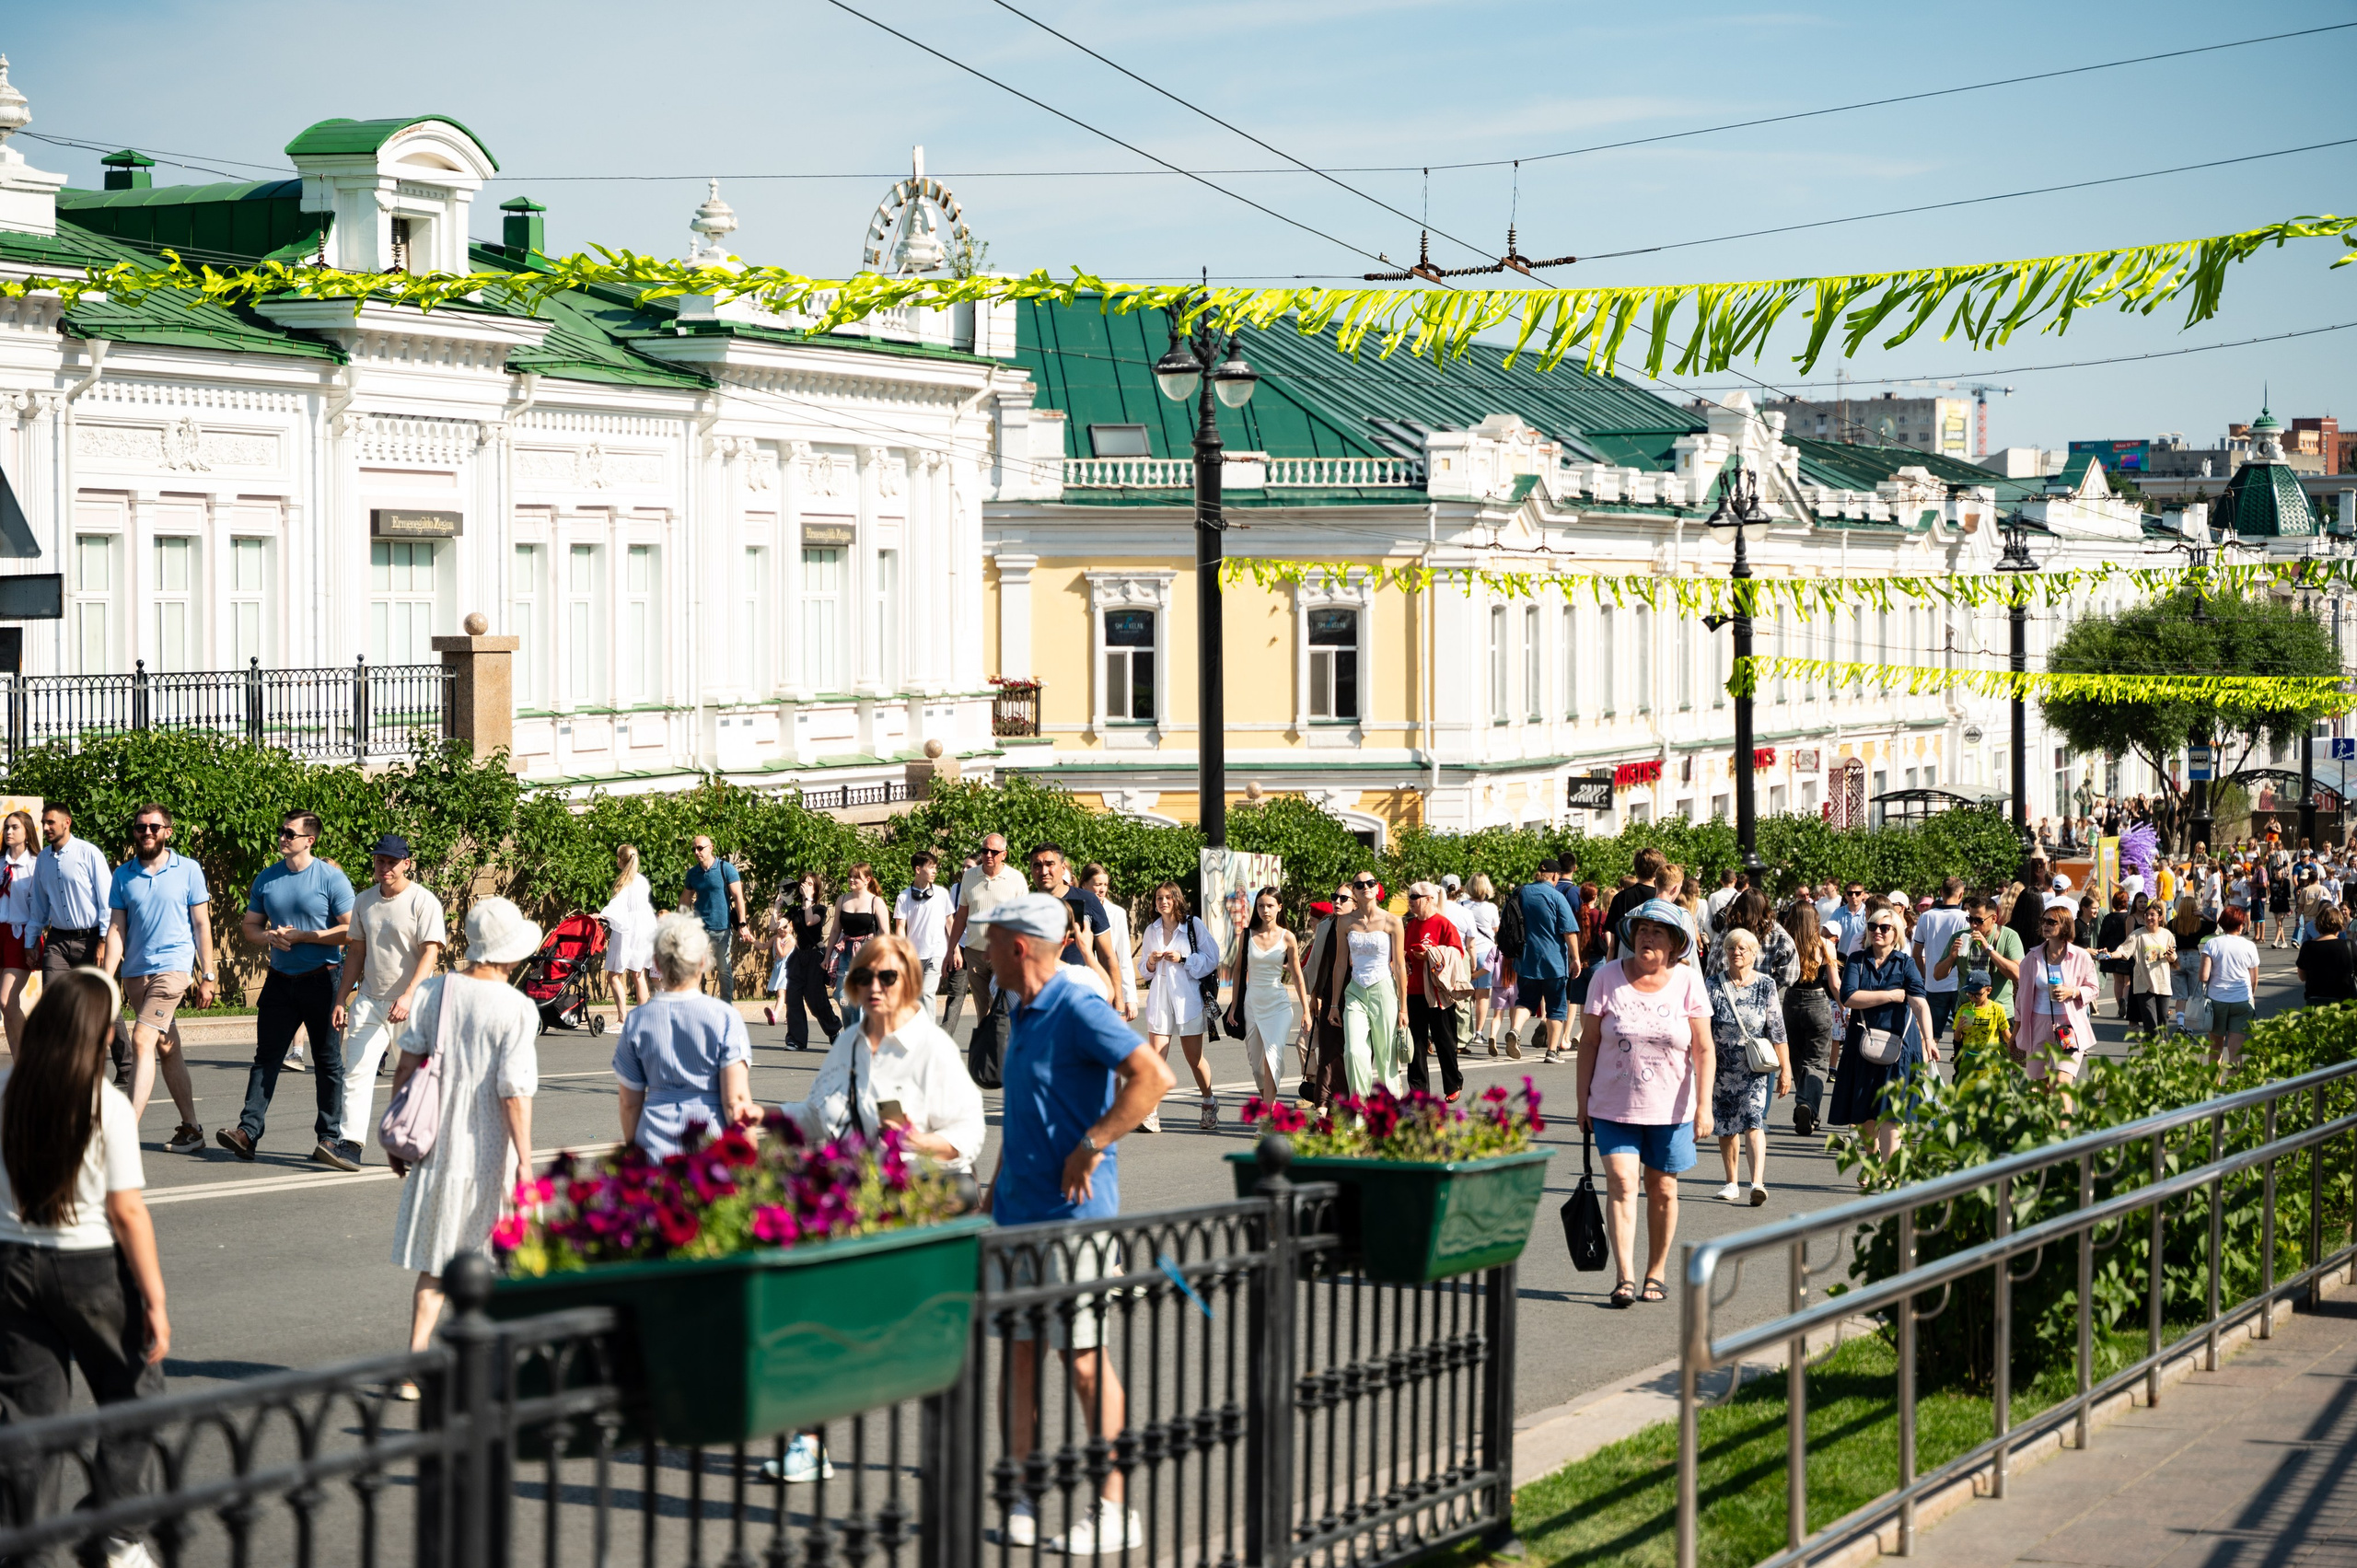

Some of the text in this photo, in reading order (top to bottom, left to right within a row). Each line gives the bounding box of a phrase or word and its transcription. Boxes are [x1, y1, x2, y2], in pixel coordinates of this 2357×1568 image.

[390, 516, 454, 534] Ermenegildo Zegna
[1614, 760, 1662, 786] ROSTIC'S
[1248, 854, 1279, 889] 1716
